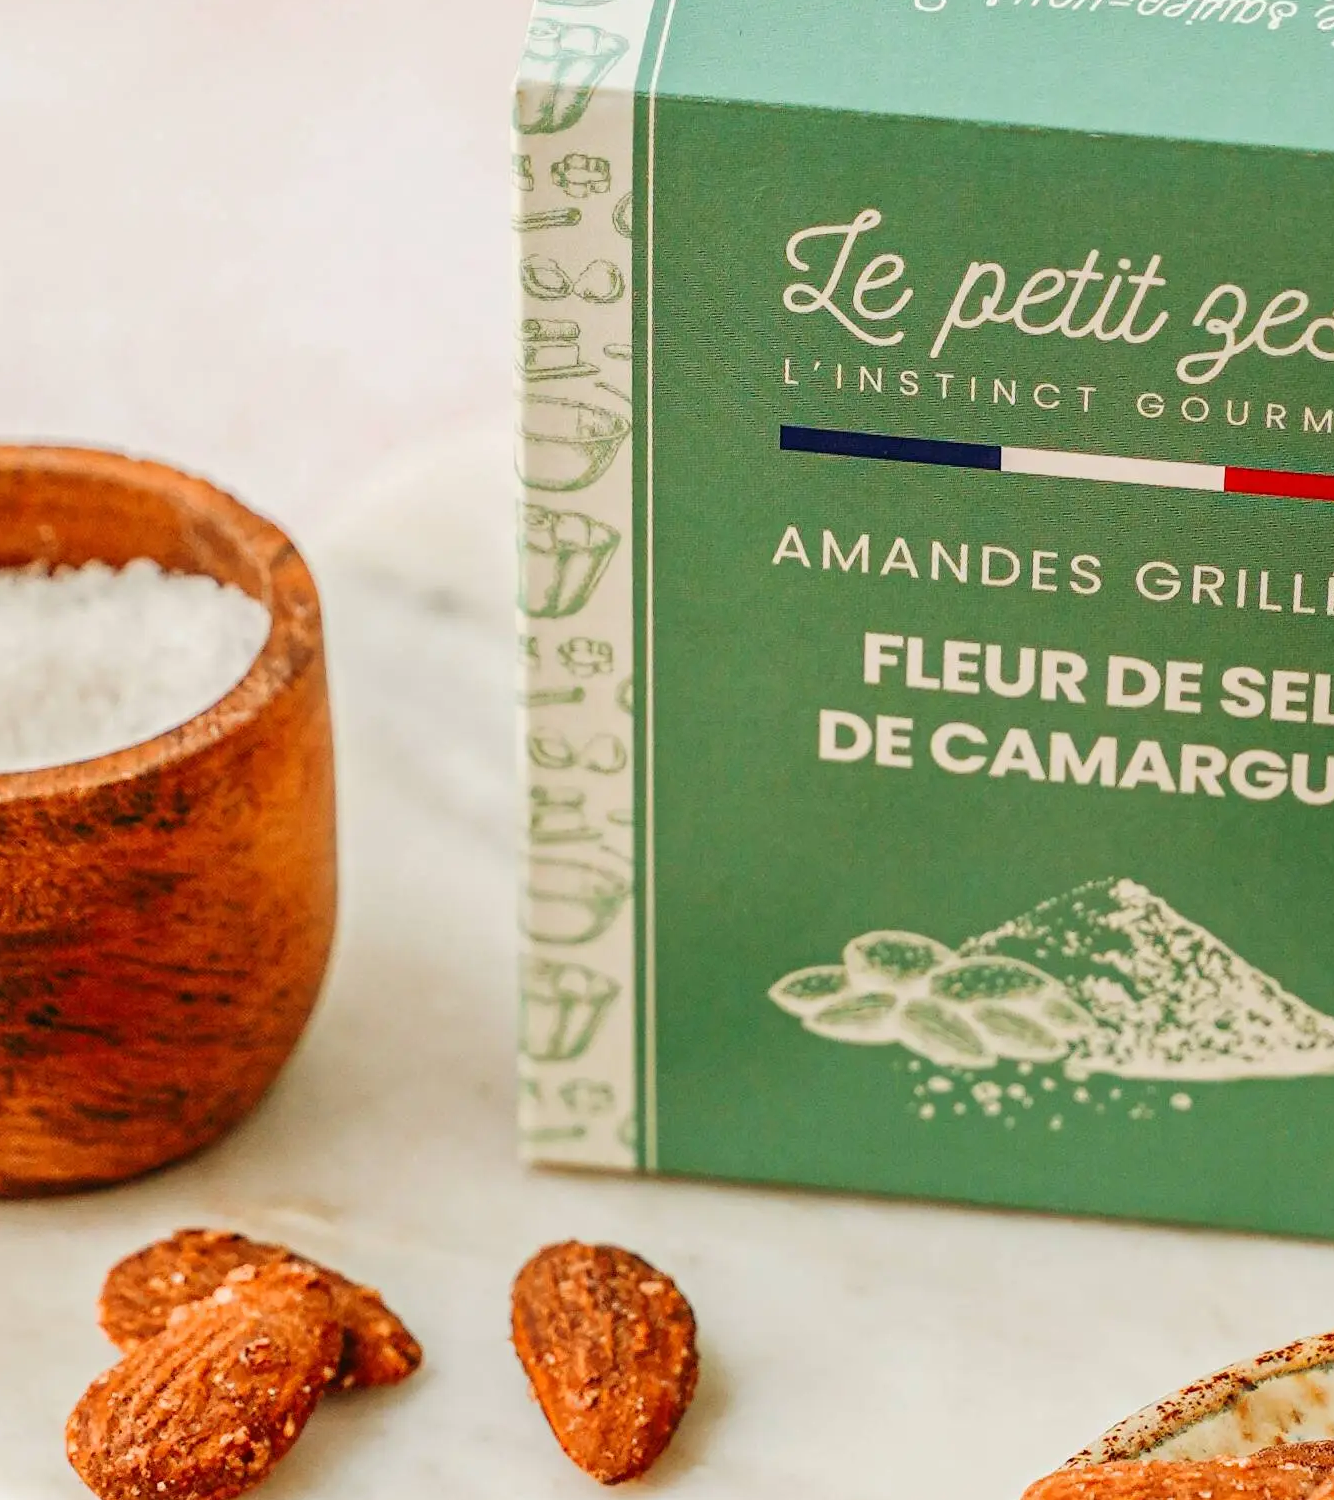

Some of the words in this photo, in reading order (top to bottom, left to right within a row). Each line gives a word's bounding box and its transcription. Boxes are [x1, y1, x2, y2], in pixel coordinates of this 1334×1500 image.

[782, 208, 914, 347] Le
[929, 248, 1169, 359] petit
[771, 525, 1103, 596] AMANDES
[863, 632, 1089, 705] FLEUR
[1106, 655, 1203, 714] DE
[817, 707, 915, 770] DE
